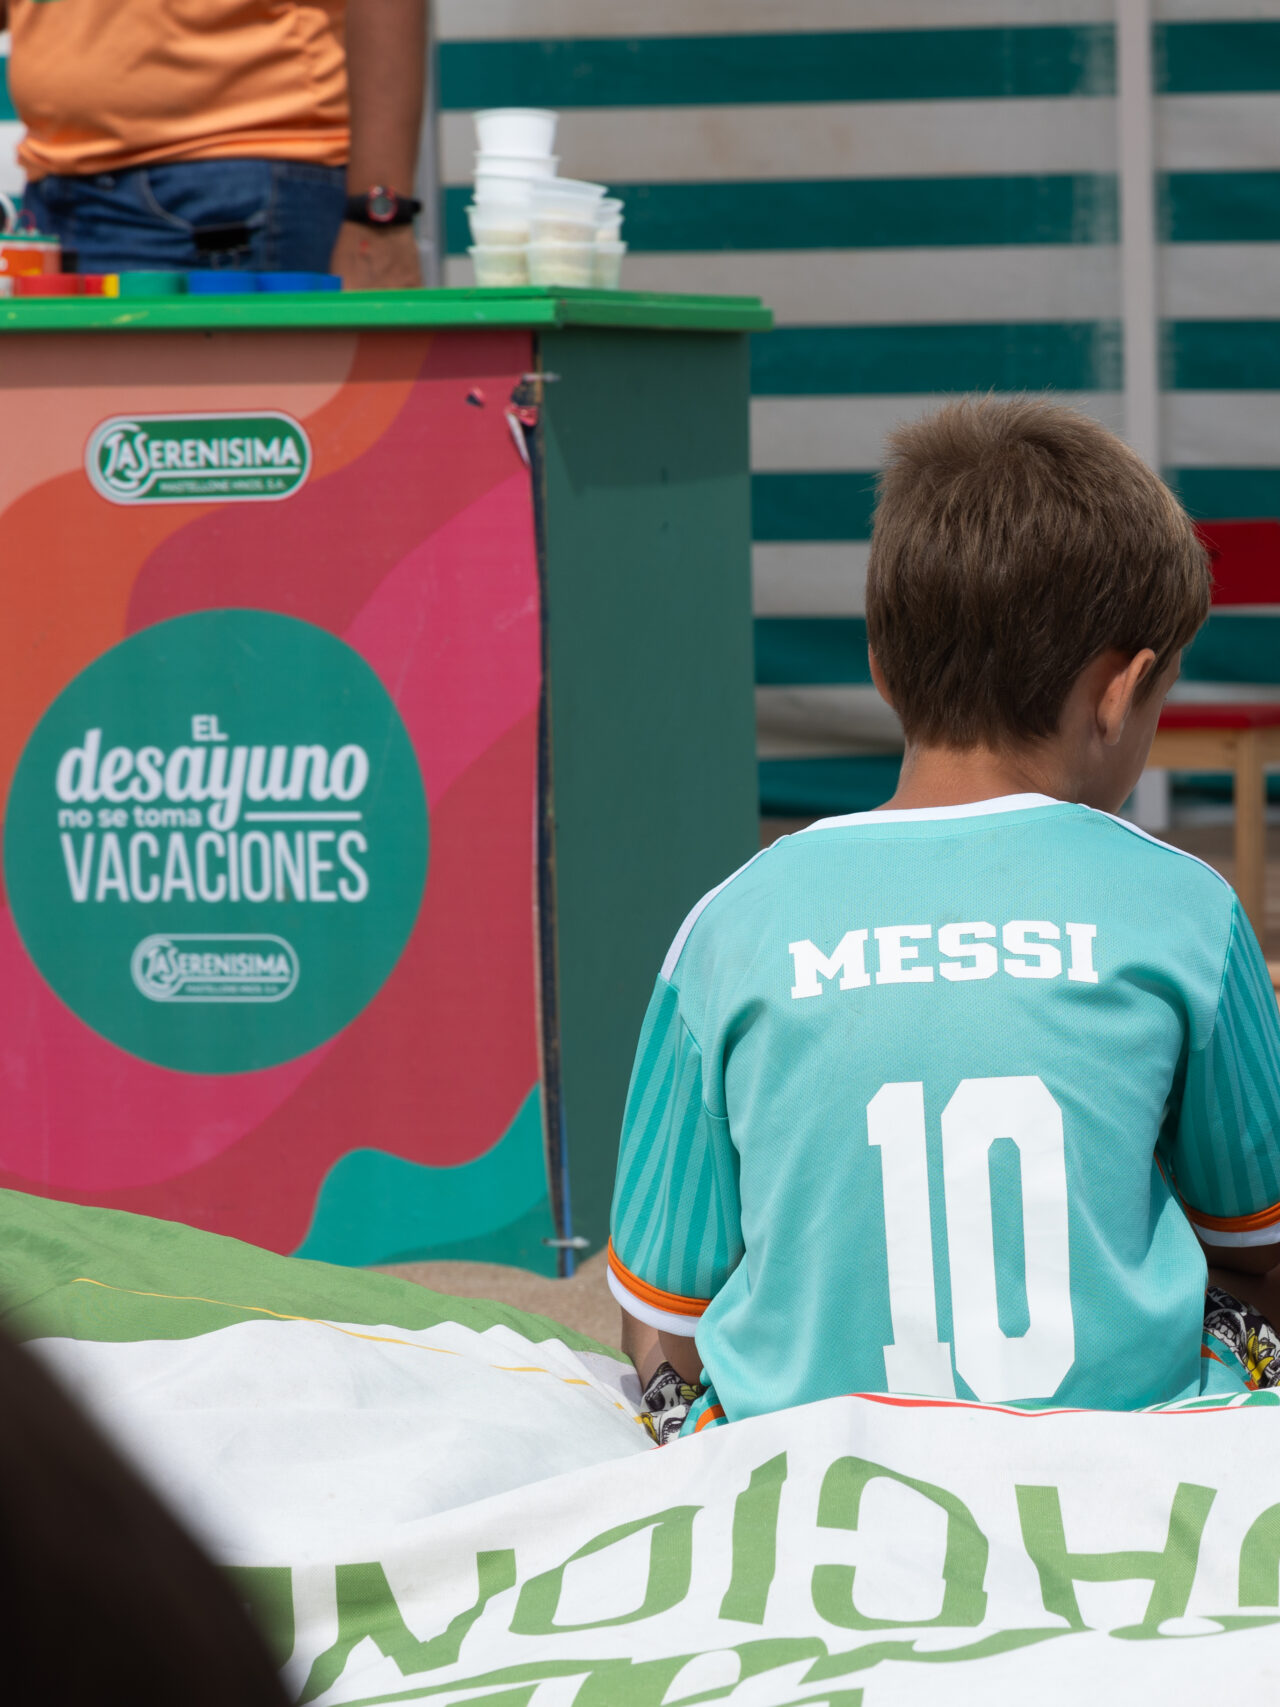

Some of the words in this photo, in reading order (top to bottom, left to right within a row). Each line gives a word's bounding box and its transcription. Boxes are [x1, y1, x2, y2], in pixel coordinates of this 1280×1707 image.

[191, 714, 228, 742] EL
[56, 728, 370, 831] desayuno
[58, 808, 93, 829] no
[98, 808, 128, 829] se
[133, 806, 202, 829] toma
[60, 830, 370, 902] VACACIONES
[788, 920, 1100, 999] MESSI
[866, 1075, 1076, 1402] 10
